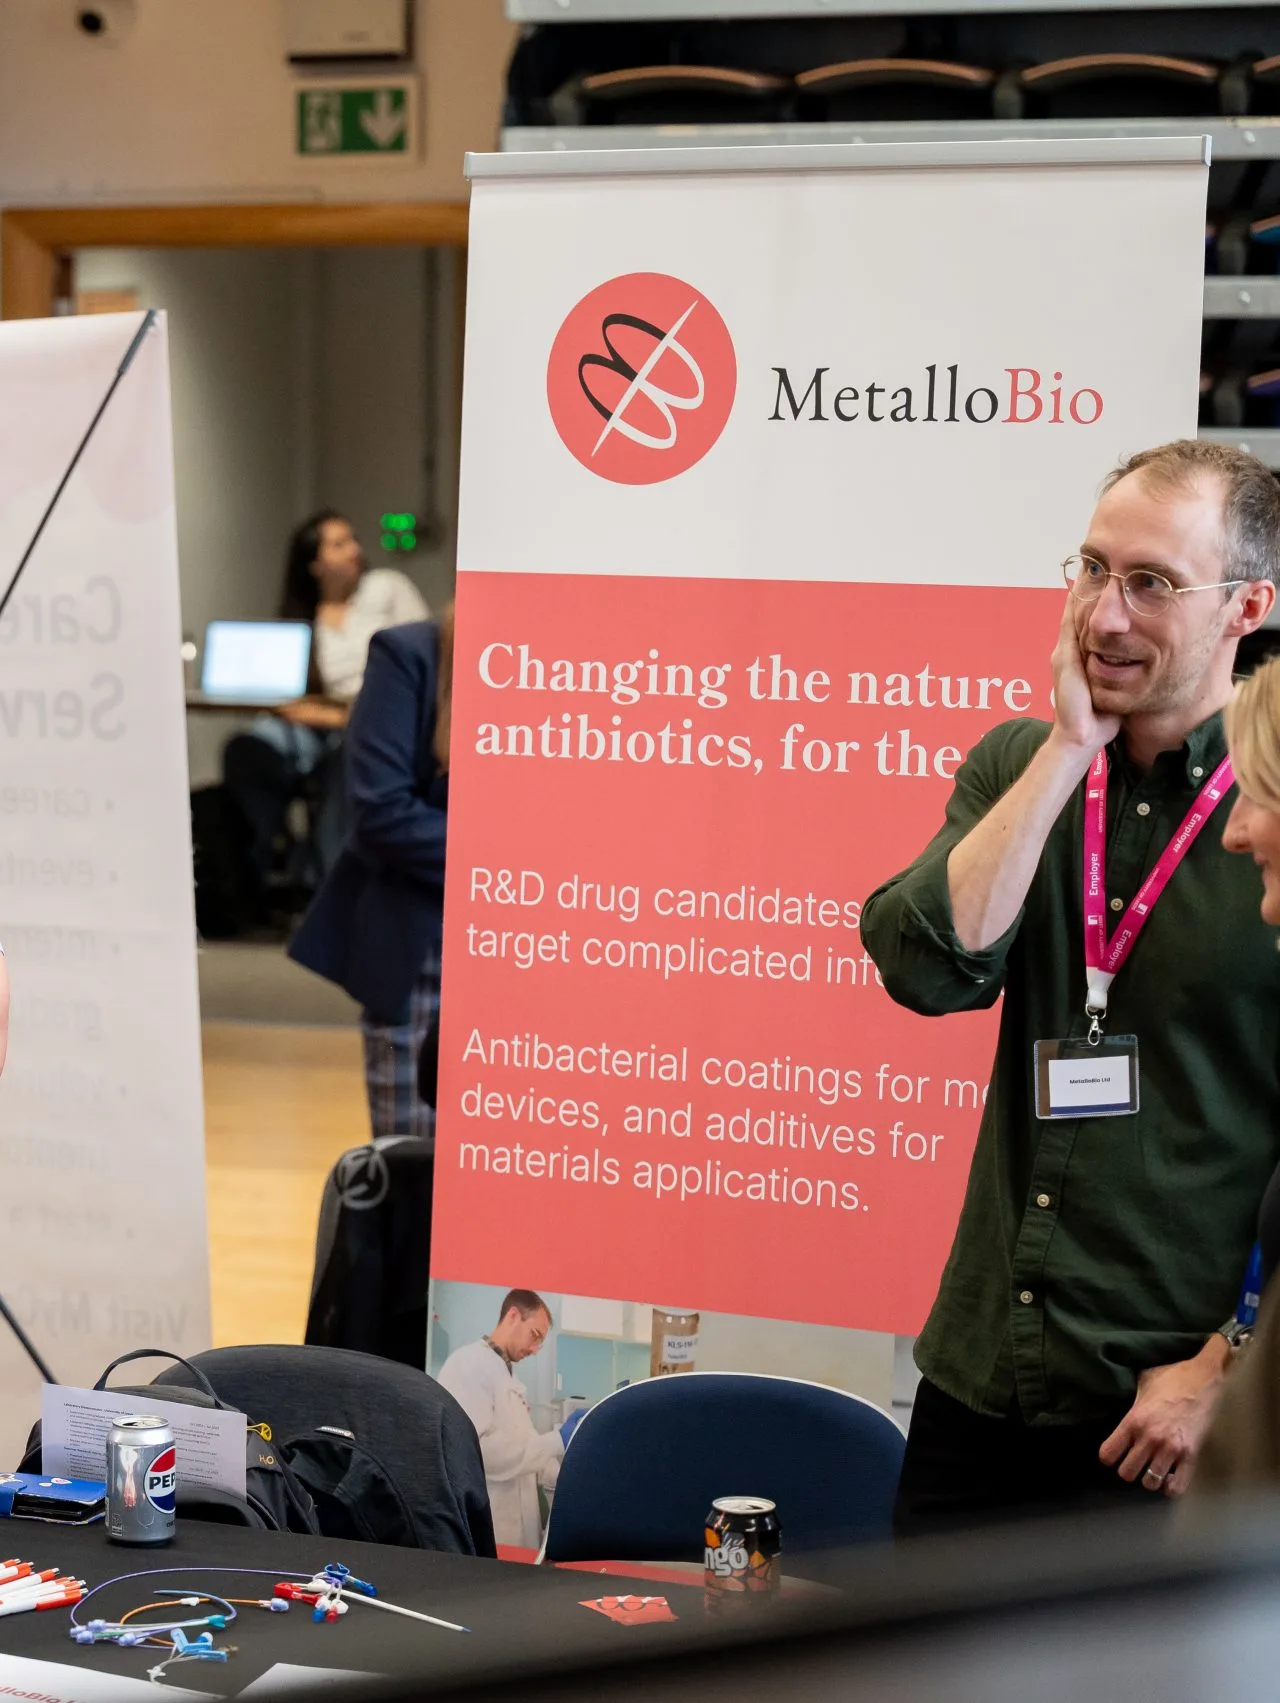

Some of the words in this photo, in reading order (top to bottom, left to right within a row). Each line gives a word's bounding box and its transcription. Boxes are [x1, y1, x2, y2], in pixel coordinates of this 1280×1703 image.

[767, 364, 1105, 426] MetalloBio
[477, 642, 732, 709] Changing
[745, 652, 831, 704] the
[846, 662, 1033, 712] nature
[474, 713, 764, 777] antibiotics,
[779, 723, 860, 772] for
[874, 729, 963, 780] the
[1172, 811, 1203, 853] Employer
[469, 866, 546, 907] R&D
[557, 873, 640, 924] drug
[652, 883, 861, 930] candidates
[1089, 852, 1099, 897] Employer
[465, 922, 571, 970] target
[581, 935, 812, 984] complicated
[1108, 929, 1132, 970] Employer
[461, 1028, 687, 1083] Antibacterial
[700, 1055, 863, 1105] coatings
[875, 1063, 930, 1104] for
[459, 1084, 610, 1137] devices,
[623, 1101, 692, 1139] and
[705, 1107, 876, 1157] additives
[888, 1121, 945, 1163] for
[458, 1138, 621, 1186] materials
[632, 1155, 870, 1213] applications.
